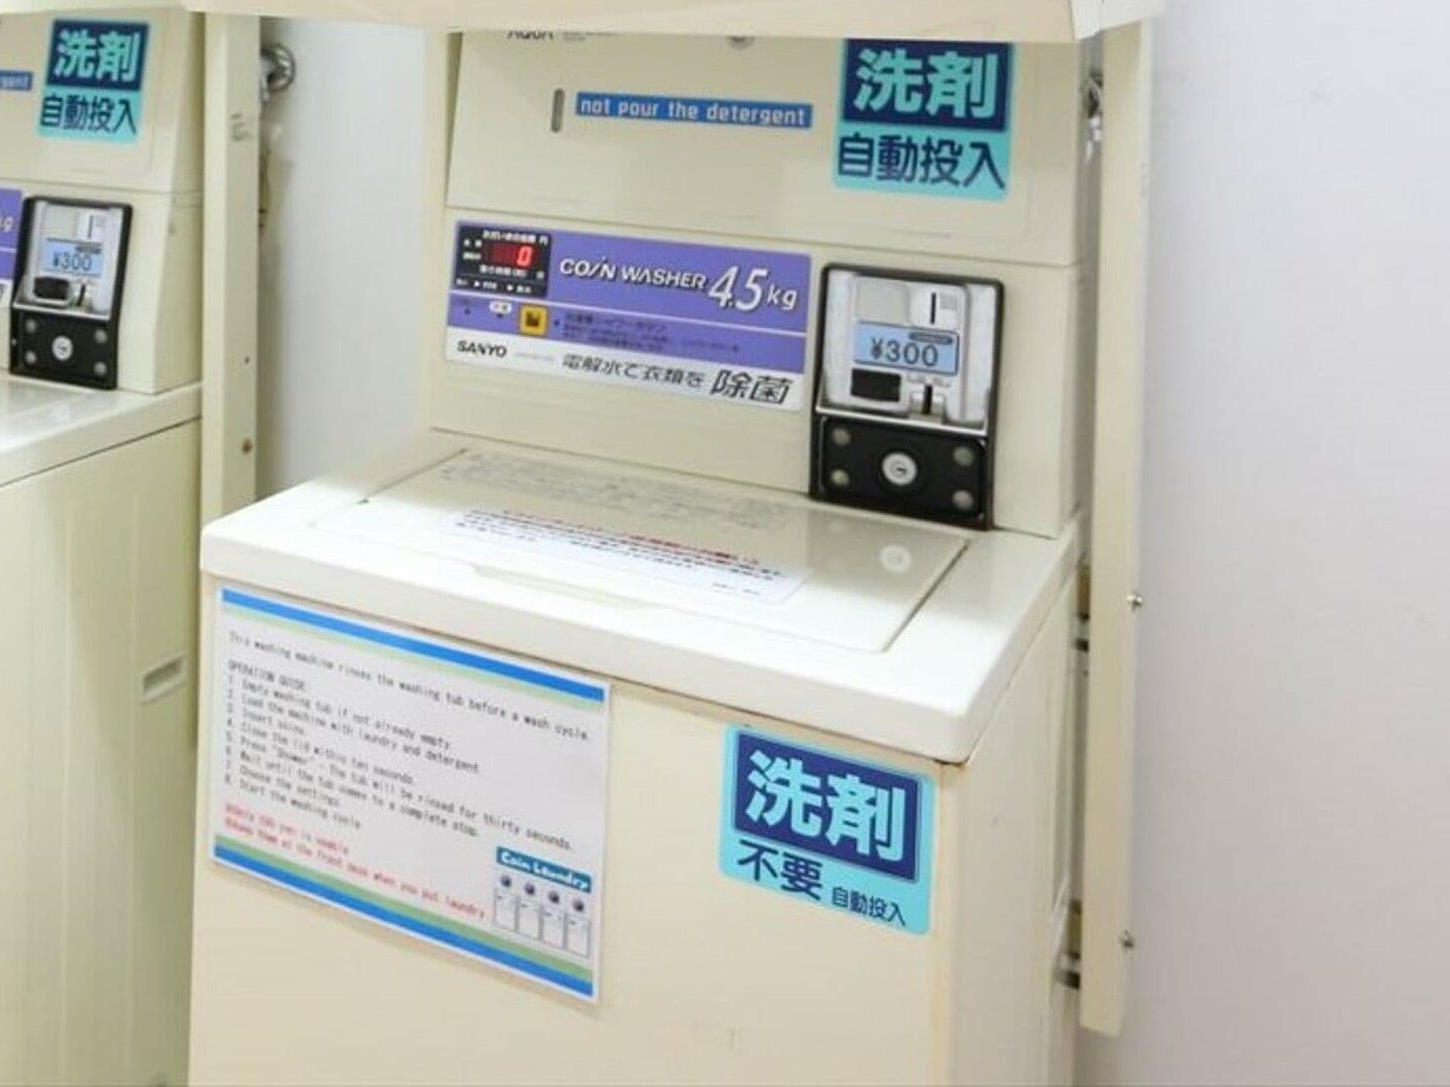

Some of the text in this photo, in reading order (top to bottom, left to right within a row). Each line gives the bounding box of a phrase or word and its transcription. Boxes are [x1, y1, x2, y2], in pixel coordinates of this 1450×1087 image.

[54, 27, 140, 82] 洗剤
[855, 47, 999, 119] 洗剤
[39, 95, 137, 135] 自動投入
[580, 98, 805, 126] not pour the detergent
[837, 133, 1006, 191] 自動投入
[53, 252, 92, 271] ¥300
[516, 245, 533, 268] 0
[621, 263, 707, 290] WASHER
[457, 339, 507, 359] SANYO
[871, 336, 939, 368] ¥300
[710, 369, 793, 406] 除菌
[745, 749, 906, 862] 洗剤
[737, 839, 906, 927] 不要 自動投入
